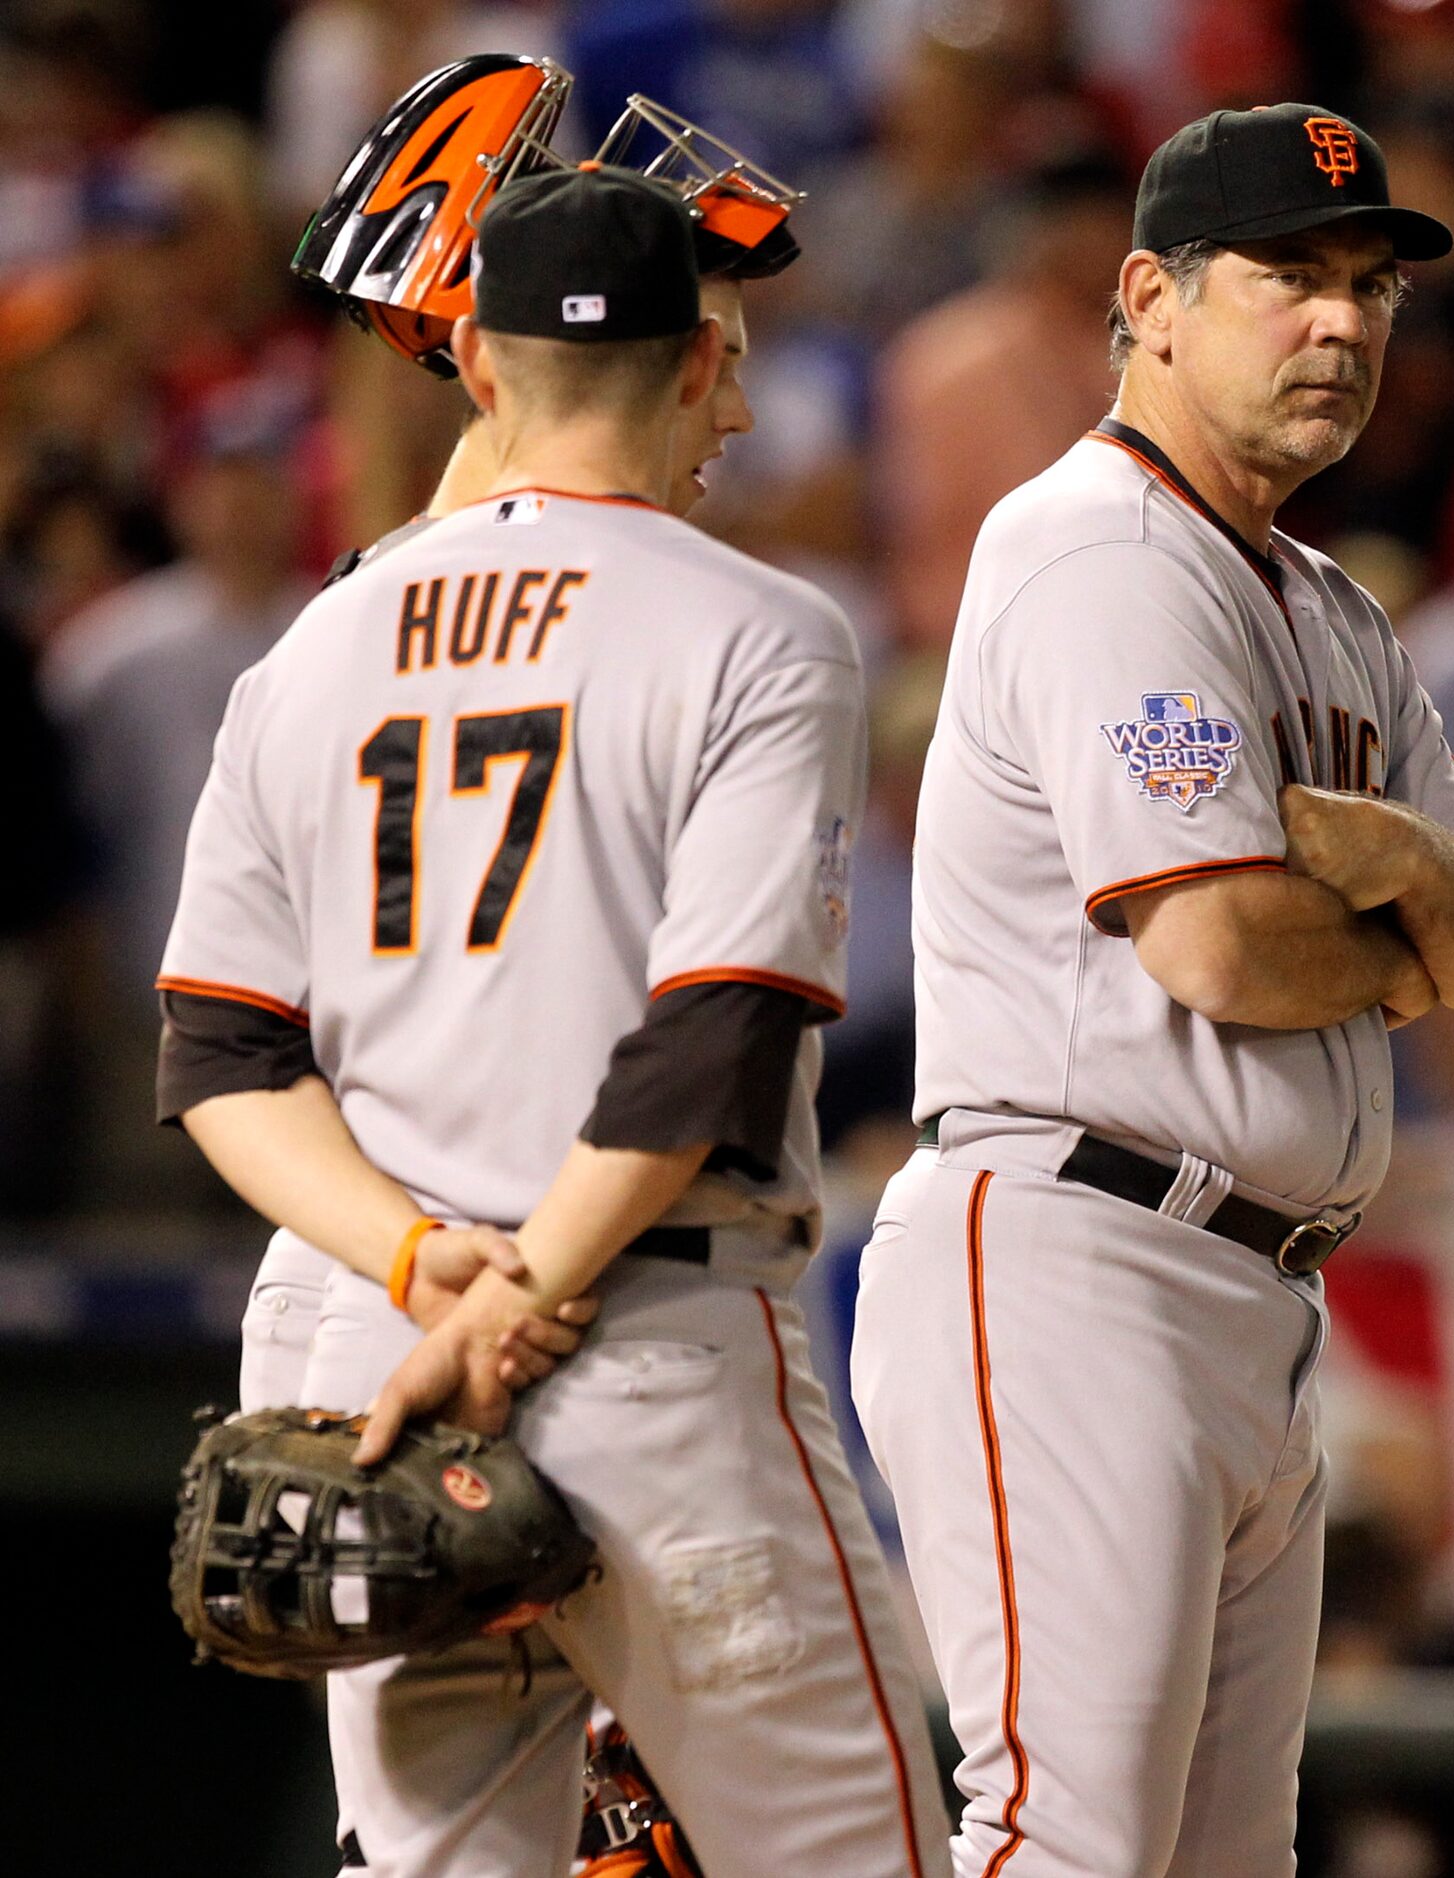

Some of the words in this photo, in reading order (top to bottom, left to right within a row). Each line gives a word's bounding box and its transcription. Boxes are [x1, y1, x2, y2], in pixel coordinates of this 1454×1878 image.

[1303, 116, 1359, 187] SF
[395, 568, 590, 676] HUFF
[1102, 719, 1240, 753] WORLD
[1127, 744, 1228, 778] SERIES
[357, 701, 573, 957] 17
